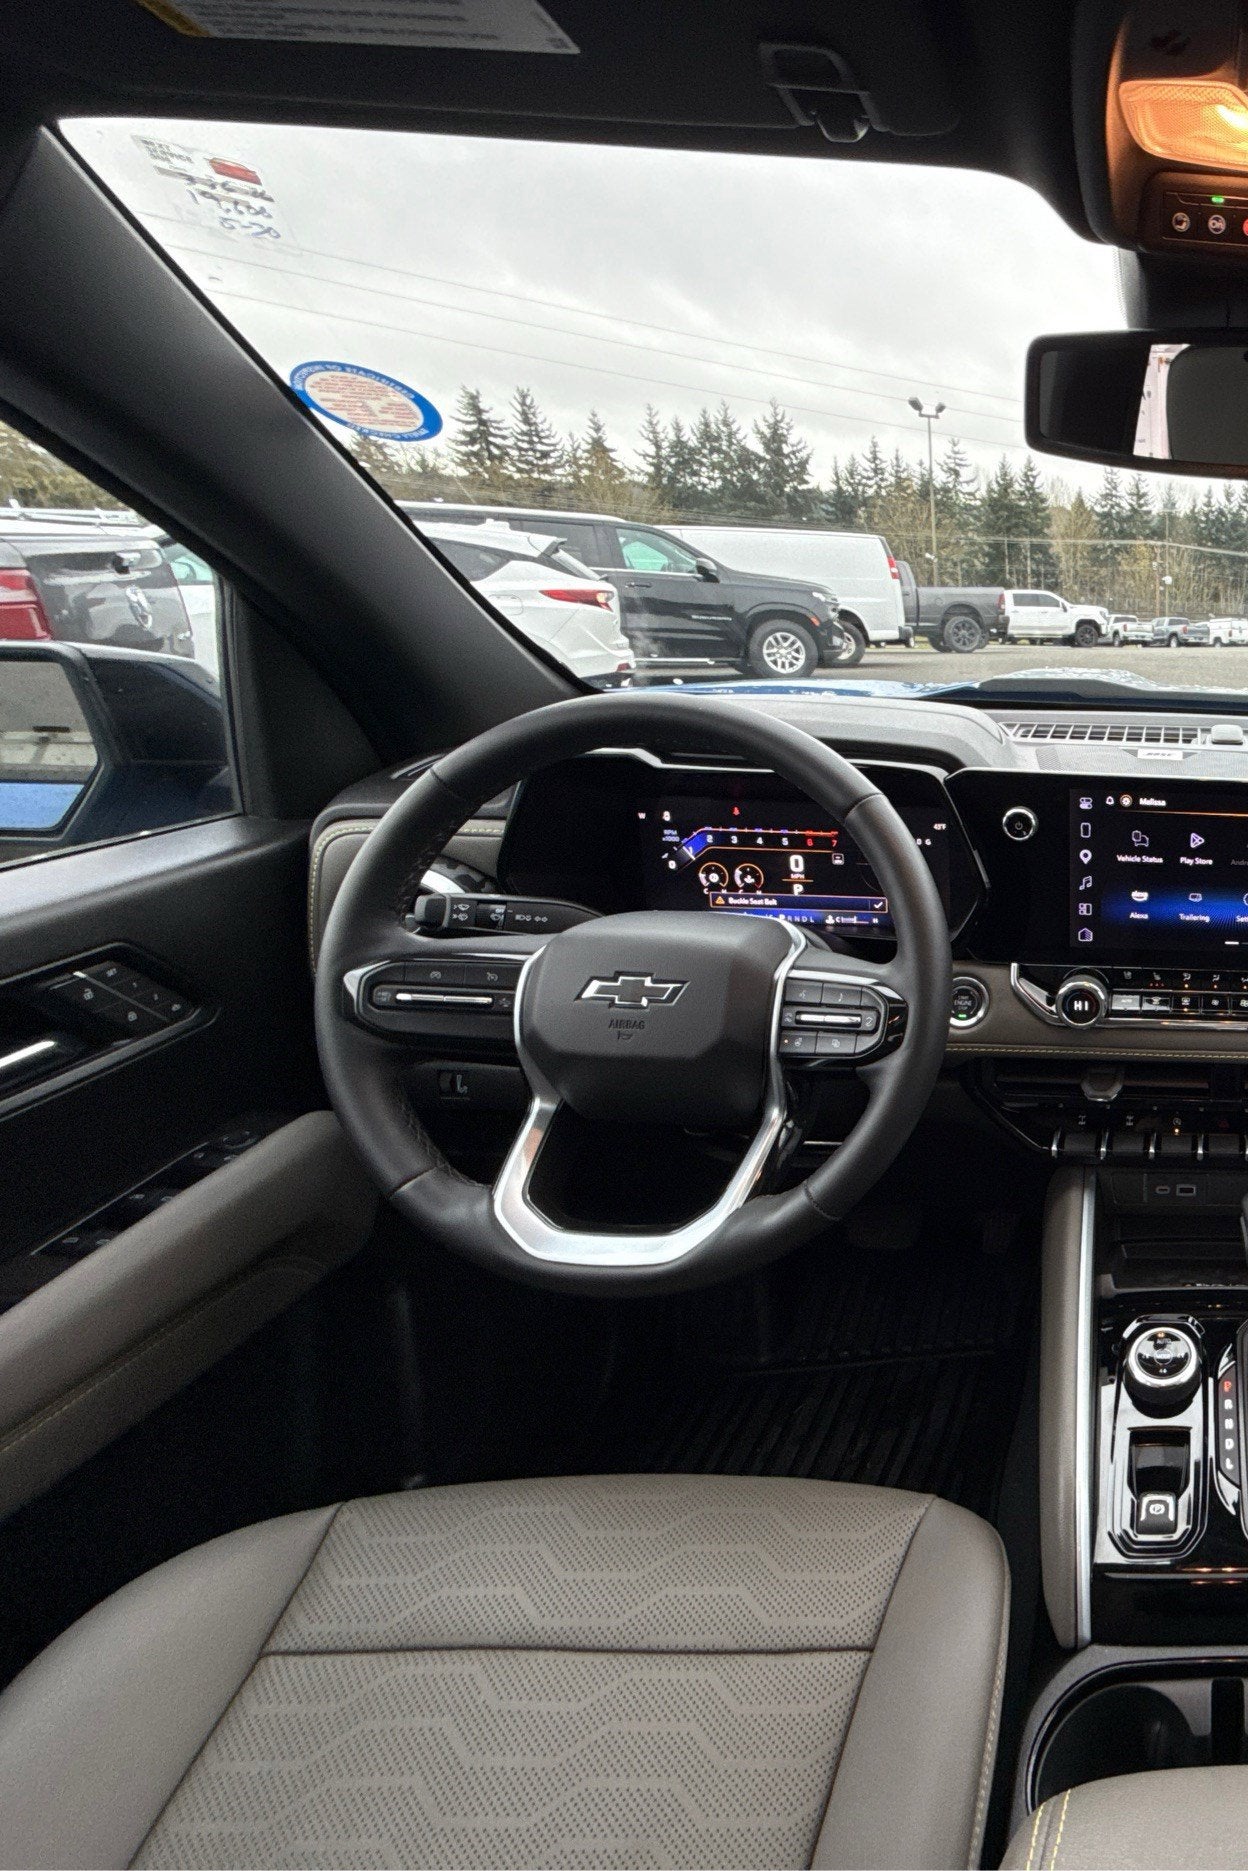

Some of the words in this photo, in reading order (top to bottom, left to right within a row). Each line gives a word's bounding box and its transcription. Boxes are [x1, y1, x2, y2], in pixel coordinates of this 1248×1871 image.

[1139, 797, 1167, 807] Melissa
[706, 834, 714, 844] 2
[730, 835, 739, 845] 3
[756, 836, 764, 846] 4
[781, 837, 790, 847] 5
[832, 839, 838, 848] 7
[789, 854, 805, 873] 0
[1116, 854, 1142, 864] Vehicle
[1142, 855, 1164, 865] Status
[1179, 857, 1195, 867] Play
[1195, 858, 1213, 866] Store
[793, 883, 804, 896] P
[728, 896, 749, 905] Buckle
[749, 898, 764, 906] Seat
[1179, 913, 1210, 923] Trailering
[1073, 1000, 1089, 1011] HI
[608, 1019, 646, 1030] AIRBAG
[1223, 1380, 1233, 1392] P
[1224, 1399, 1234, 1410] R
[1224, 1418, 1235, 1430] N
[1225, 1438, 1235, 1450] D
[1225, 1457, 1234, 1470] L
